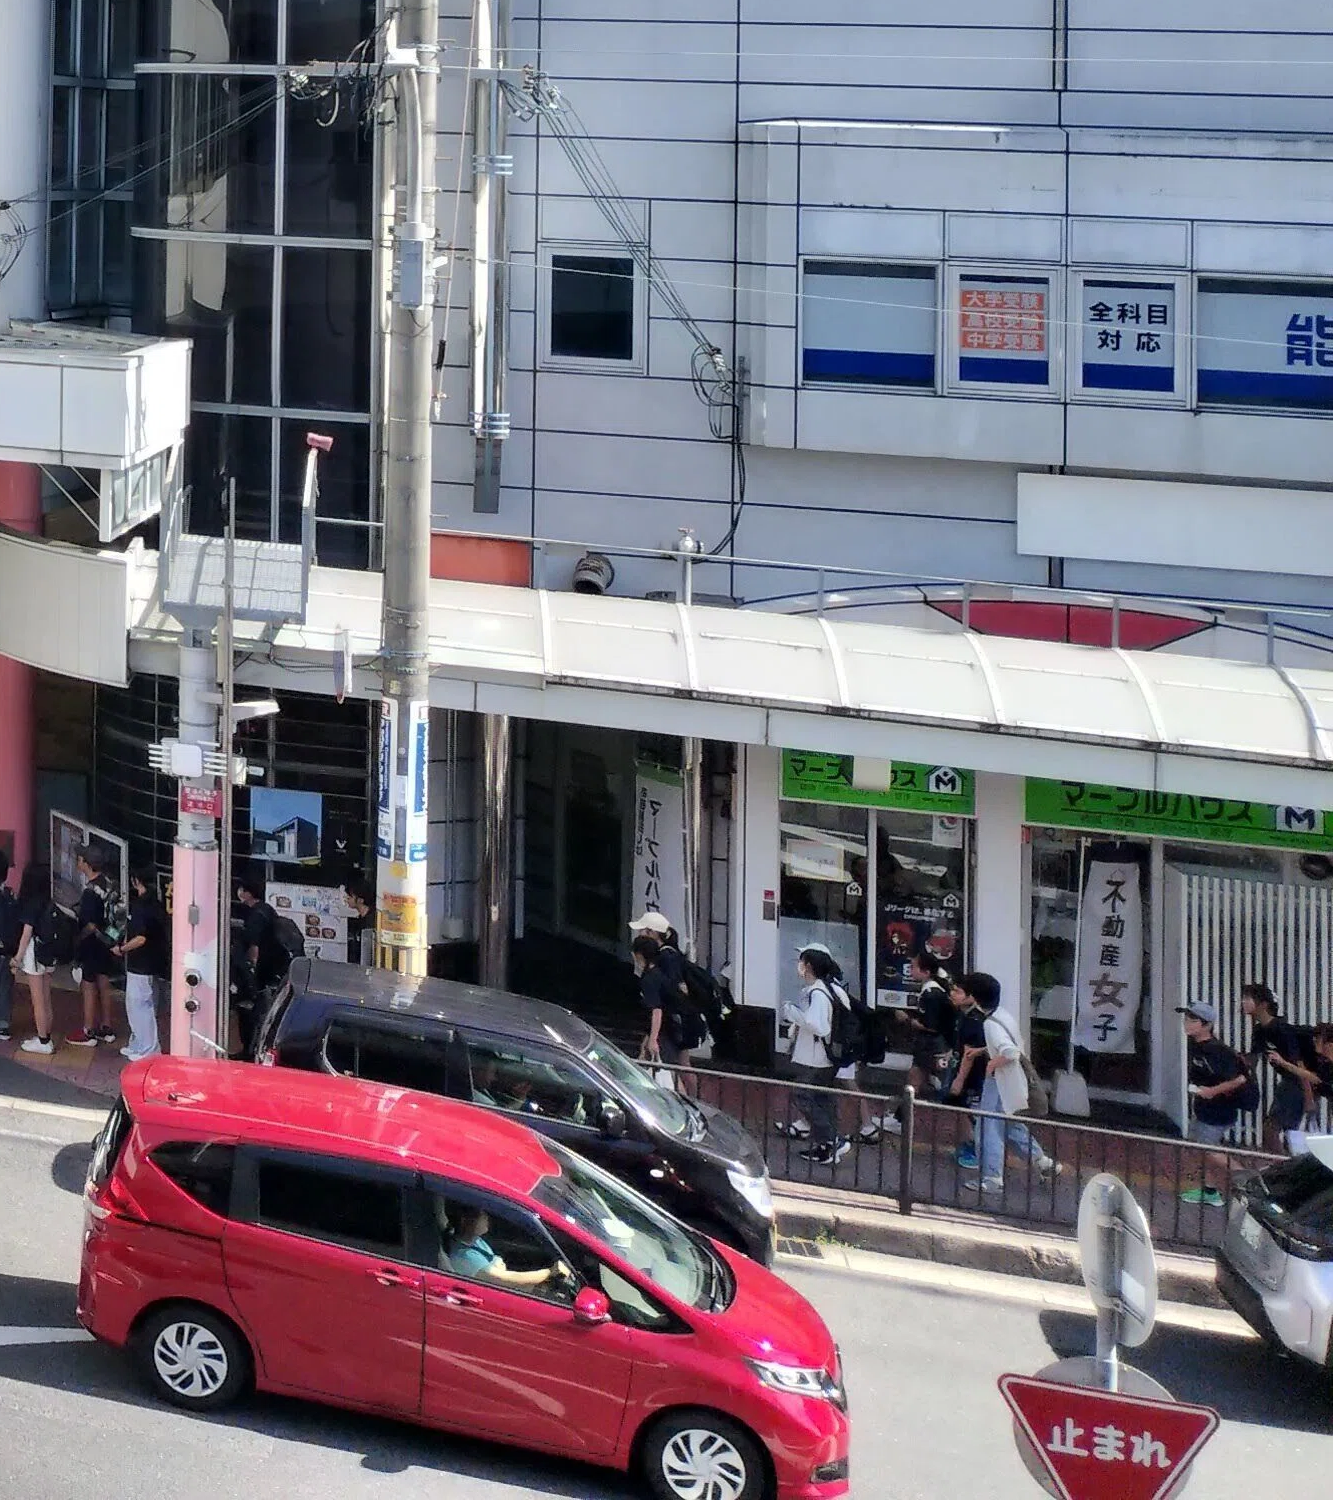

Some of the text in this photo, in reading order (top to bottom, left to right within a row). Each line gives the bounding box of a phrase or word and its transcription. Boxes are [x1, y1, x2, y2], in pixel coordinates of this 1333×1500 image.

[966, 291, 1039, 309] 大学受験
[1088, 301, 1168, 325] 全科目
[966, 332, 1039, 350] 中学受験
[1097, 329, 1162, 353] 対応
[1089, 879, 1130, 1042] 不動産女子
[1046, 1417, 1172, 1468] 止まれ
